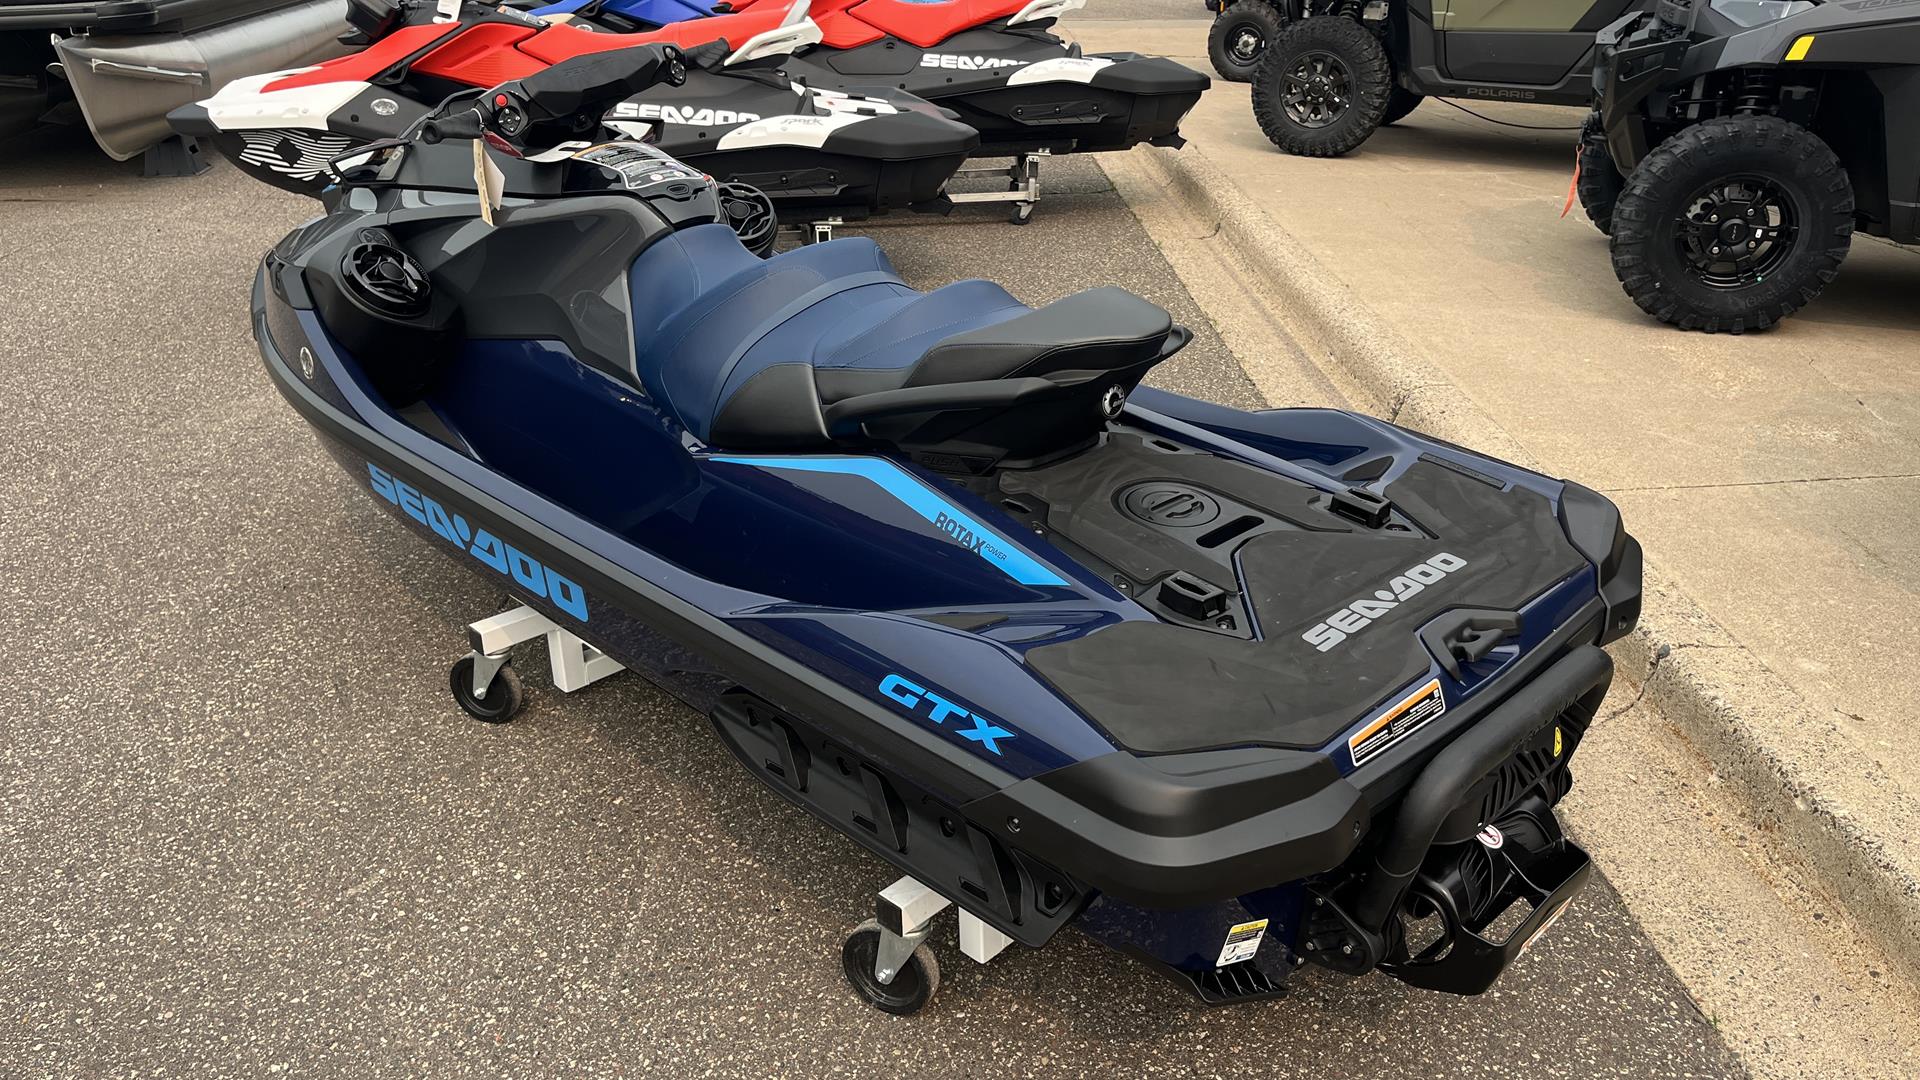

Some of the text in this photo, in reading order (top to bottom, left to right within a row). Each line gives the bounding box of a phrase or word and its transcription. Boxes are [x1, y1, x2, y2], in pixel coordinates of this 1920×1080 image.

[1467, 87, 1536, 99] POLARIS
[934, 511, 1007, 560] ROTAX POWER
[878, 673, 1017, 757] GTX
